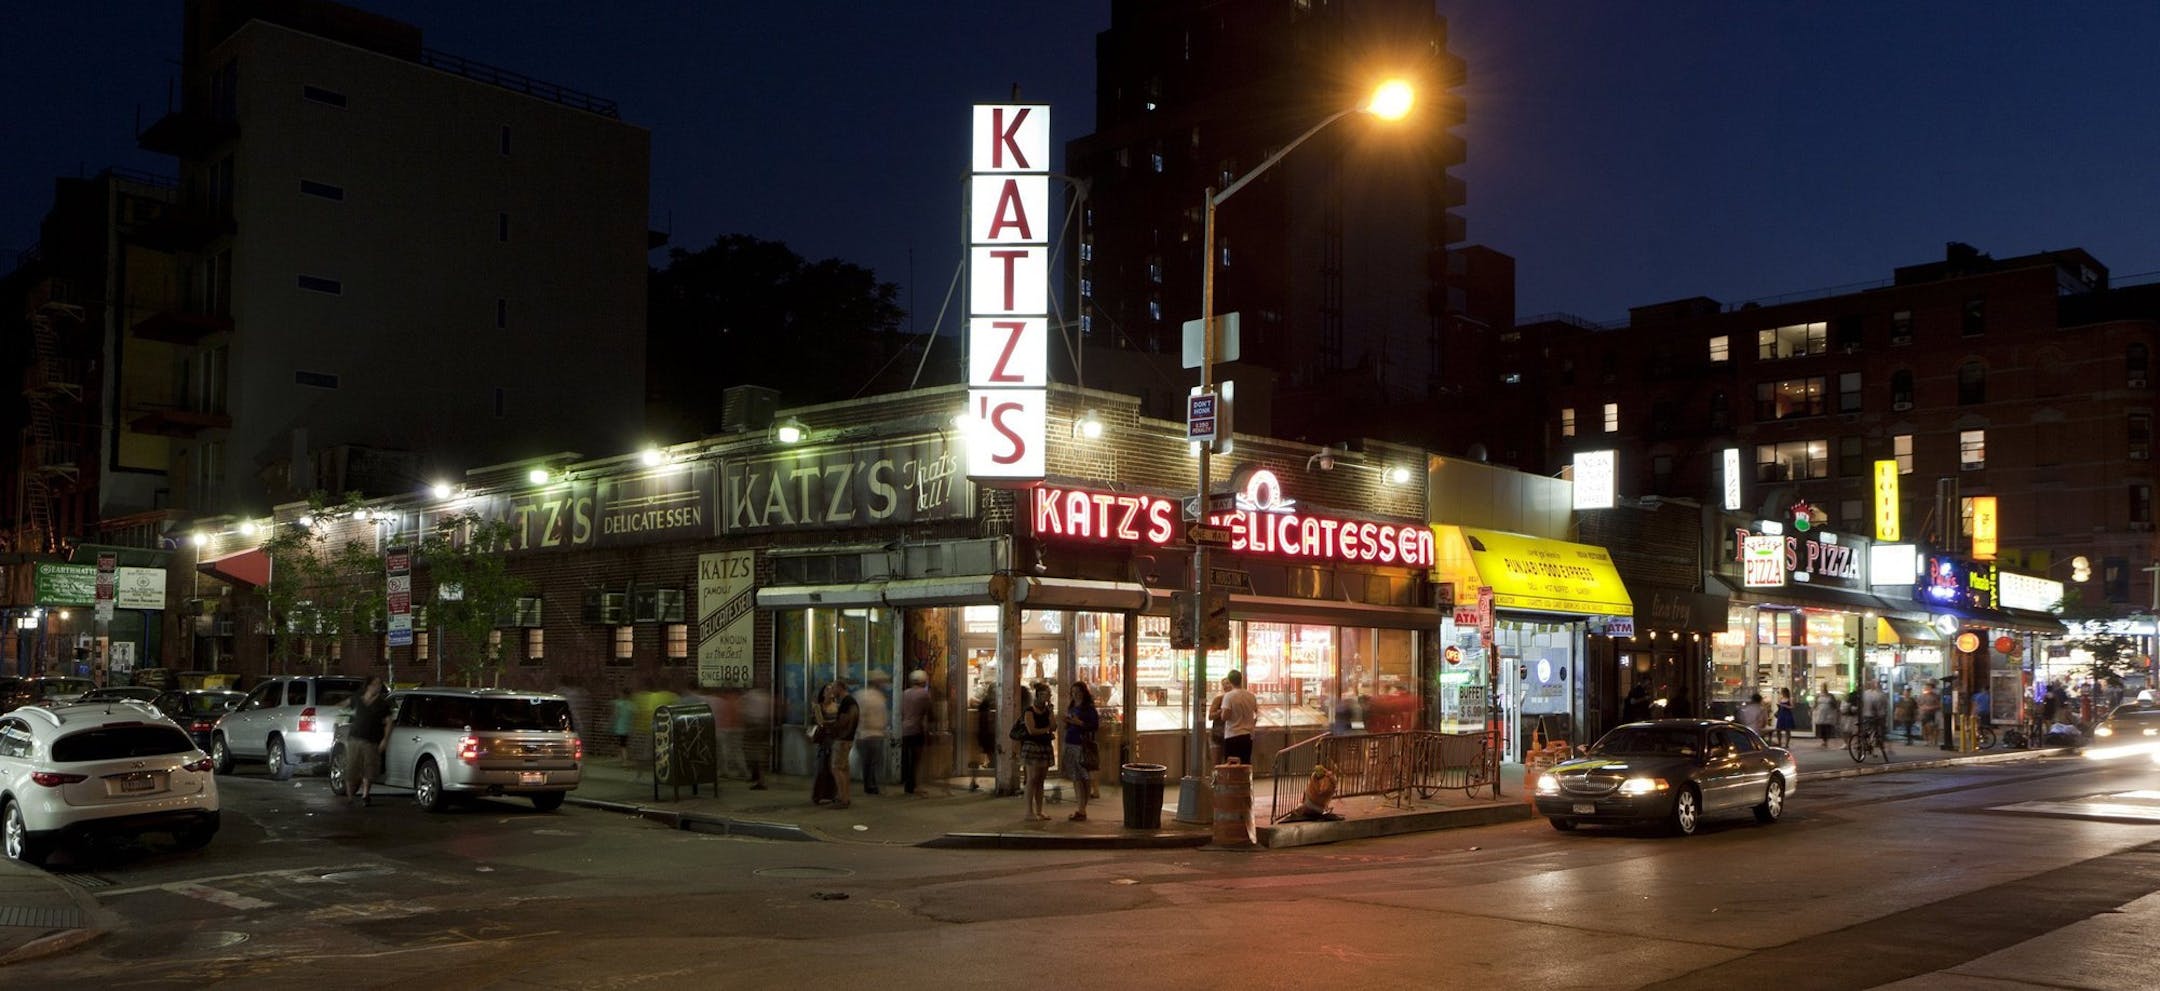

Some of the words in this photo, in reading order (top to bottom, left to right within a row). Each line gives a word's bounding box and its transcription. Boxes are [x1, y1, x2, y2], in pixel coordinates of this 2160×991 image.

[980, 108, 1032, 464] KATZ'S
[1193, 400, 1211, 408] DON'T
[903, 451, 957, 490] That's
[728, 459, 898, 529] KATZ'S
[604, 508, 701, 534] DELICATESSEN
[1036, 488, 1171, 543] KATZ'S
[1211, 511, 1434, 566] ELICATESSEN
[701, 557, 750, 580] KATZ'S
[1539, 562, 1561, 578] FOOD
[1746, 559, 1782, 584] PIZZA
[1807, 541, 1860, 579] PIZZA
[1607, 623, 1632, 632] ATM
[702, 671, 720, 680] SINCE
[720, 665, 750, 681] 1888
[1460, 686, 1483, 698] BUFFET
